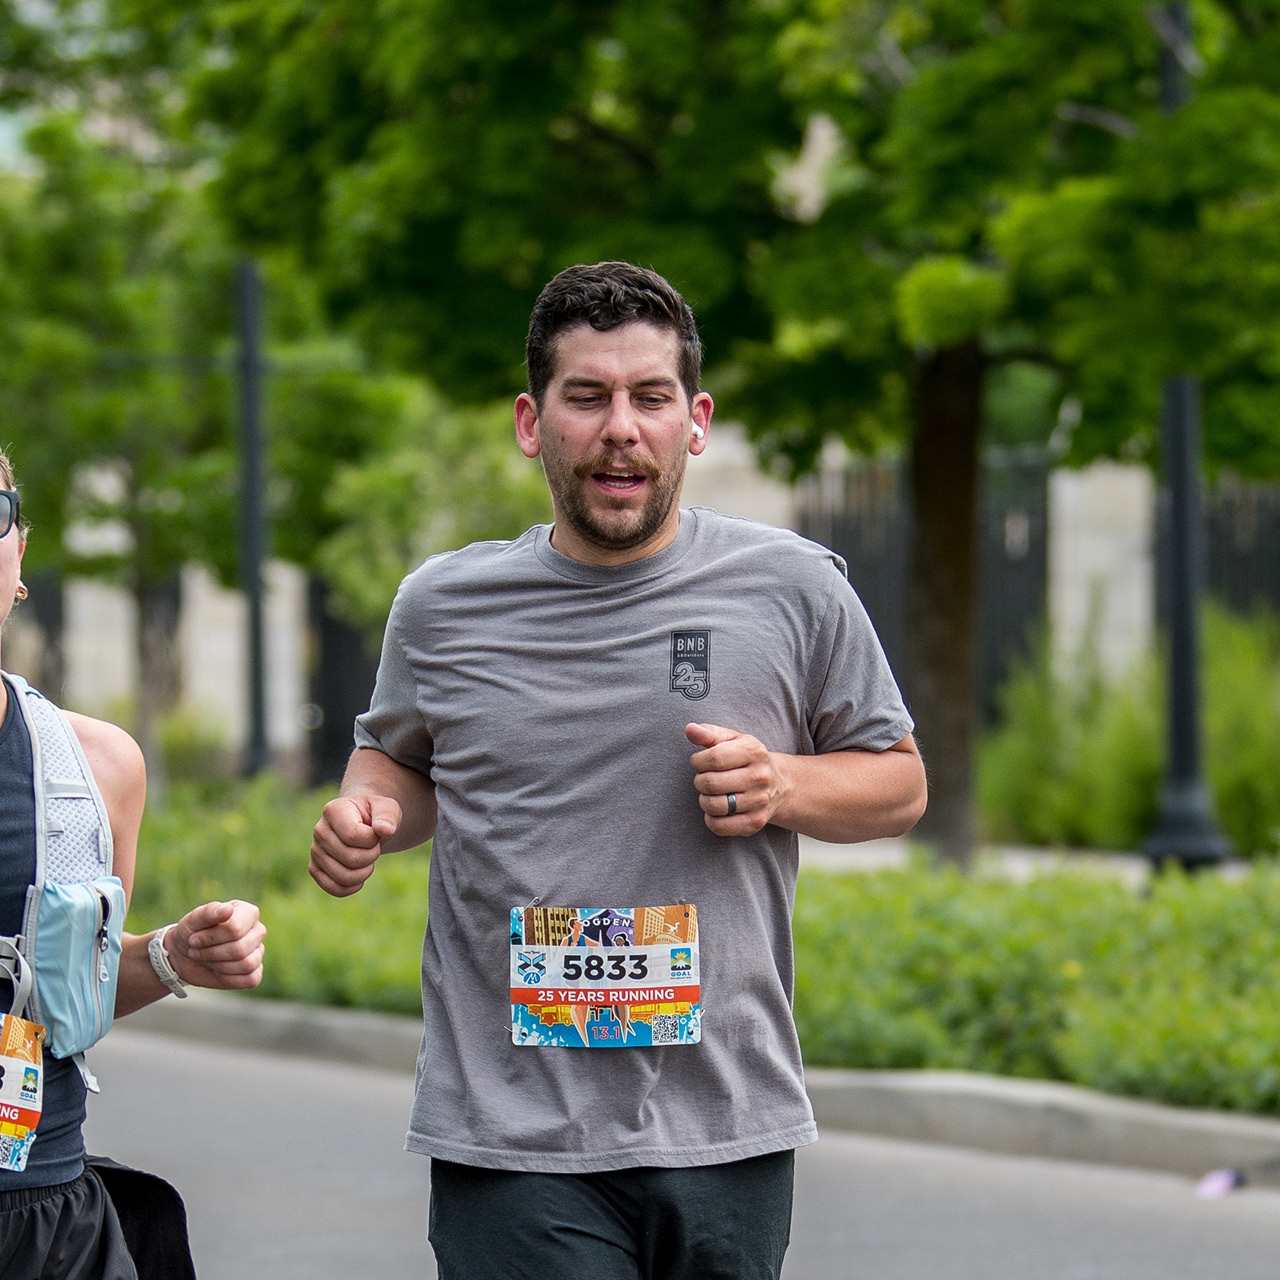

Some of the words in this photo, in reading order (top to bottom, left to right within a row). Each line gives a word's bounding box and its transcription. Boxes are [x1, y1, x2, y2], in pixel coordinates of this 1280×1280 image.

[583, 918, 630, 927] OGDEN
[562, 954, 648, 981] 5833
[538, 990, 554, 1002] 25
[559, 991, 605, 1002] YEARS
[610, 989, 675, 1001] RUNNING
[592, 1026, 620, 1040] 13.1
